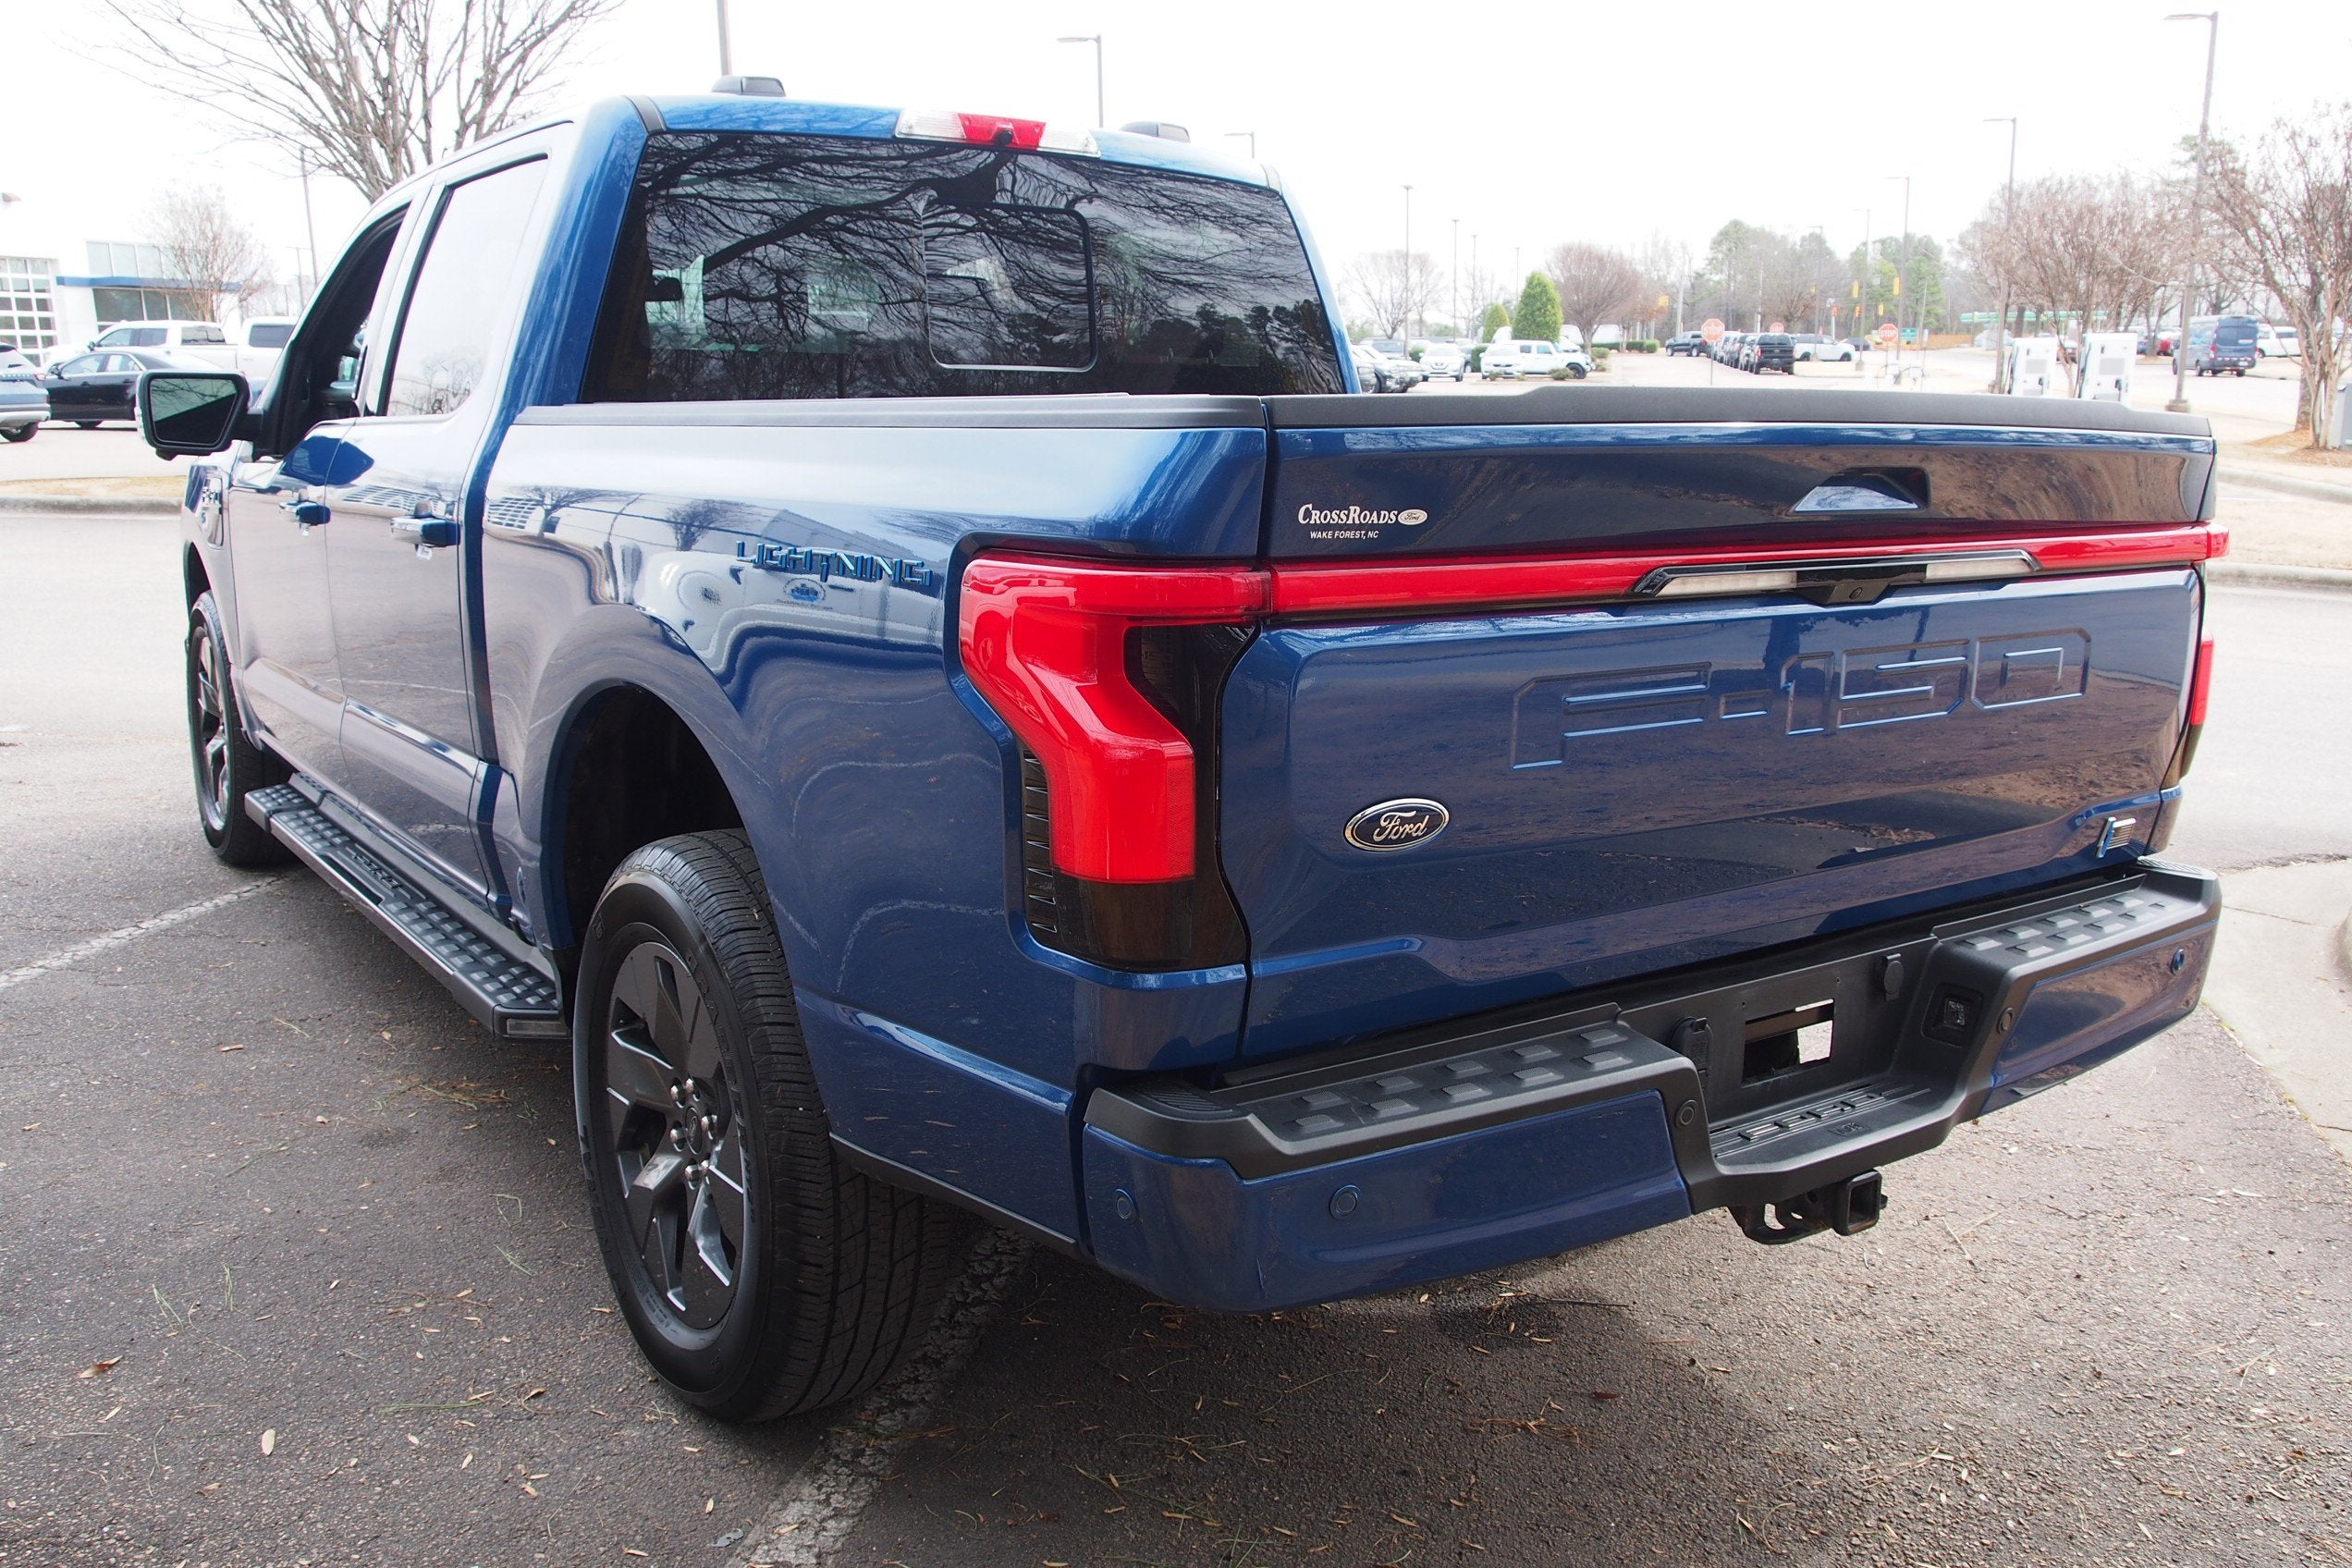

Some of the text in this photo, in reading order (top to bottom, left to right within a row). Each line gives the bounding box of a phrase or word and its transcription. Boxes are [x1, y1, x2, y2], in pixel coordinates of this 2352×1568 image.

[1310, 530, 1379, 539] WAKE FOREST, NC
[736, 540, 933, 587] LIGHTNING
[1511, 627, 2091, 769] F-150
[1372, 810, 1429, 842] Ford
[1736, 1092, 1887, 1143] FORD
